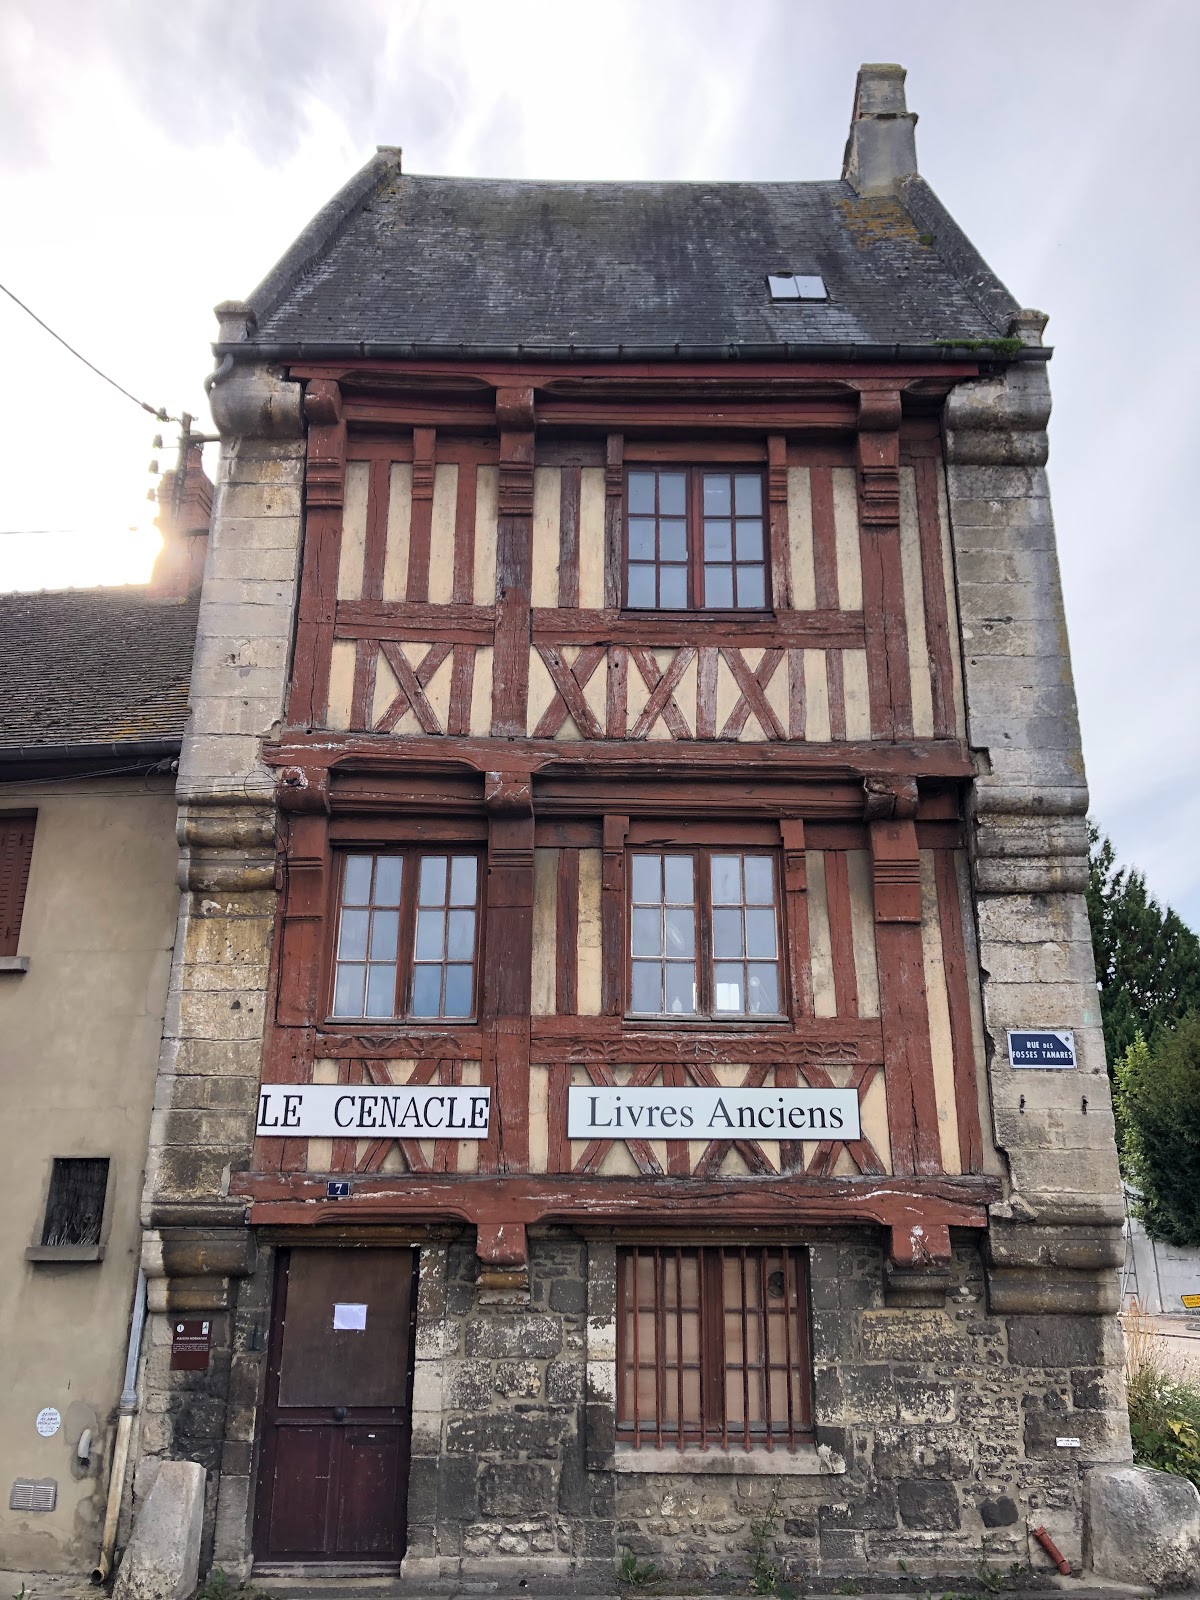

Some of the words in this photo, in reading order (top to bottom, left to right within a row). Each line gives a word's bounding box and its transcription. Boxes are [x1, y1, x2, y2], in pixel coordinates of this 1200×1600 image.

[258, 1094, 303, 1127] LE
[334, 1095, 489, 1129] CENACLE
[587, 1096, 694, 1128] Livres
[706, 1097, 844, 1129] Anciens
[335, 1183, 343, 1195] 7
